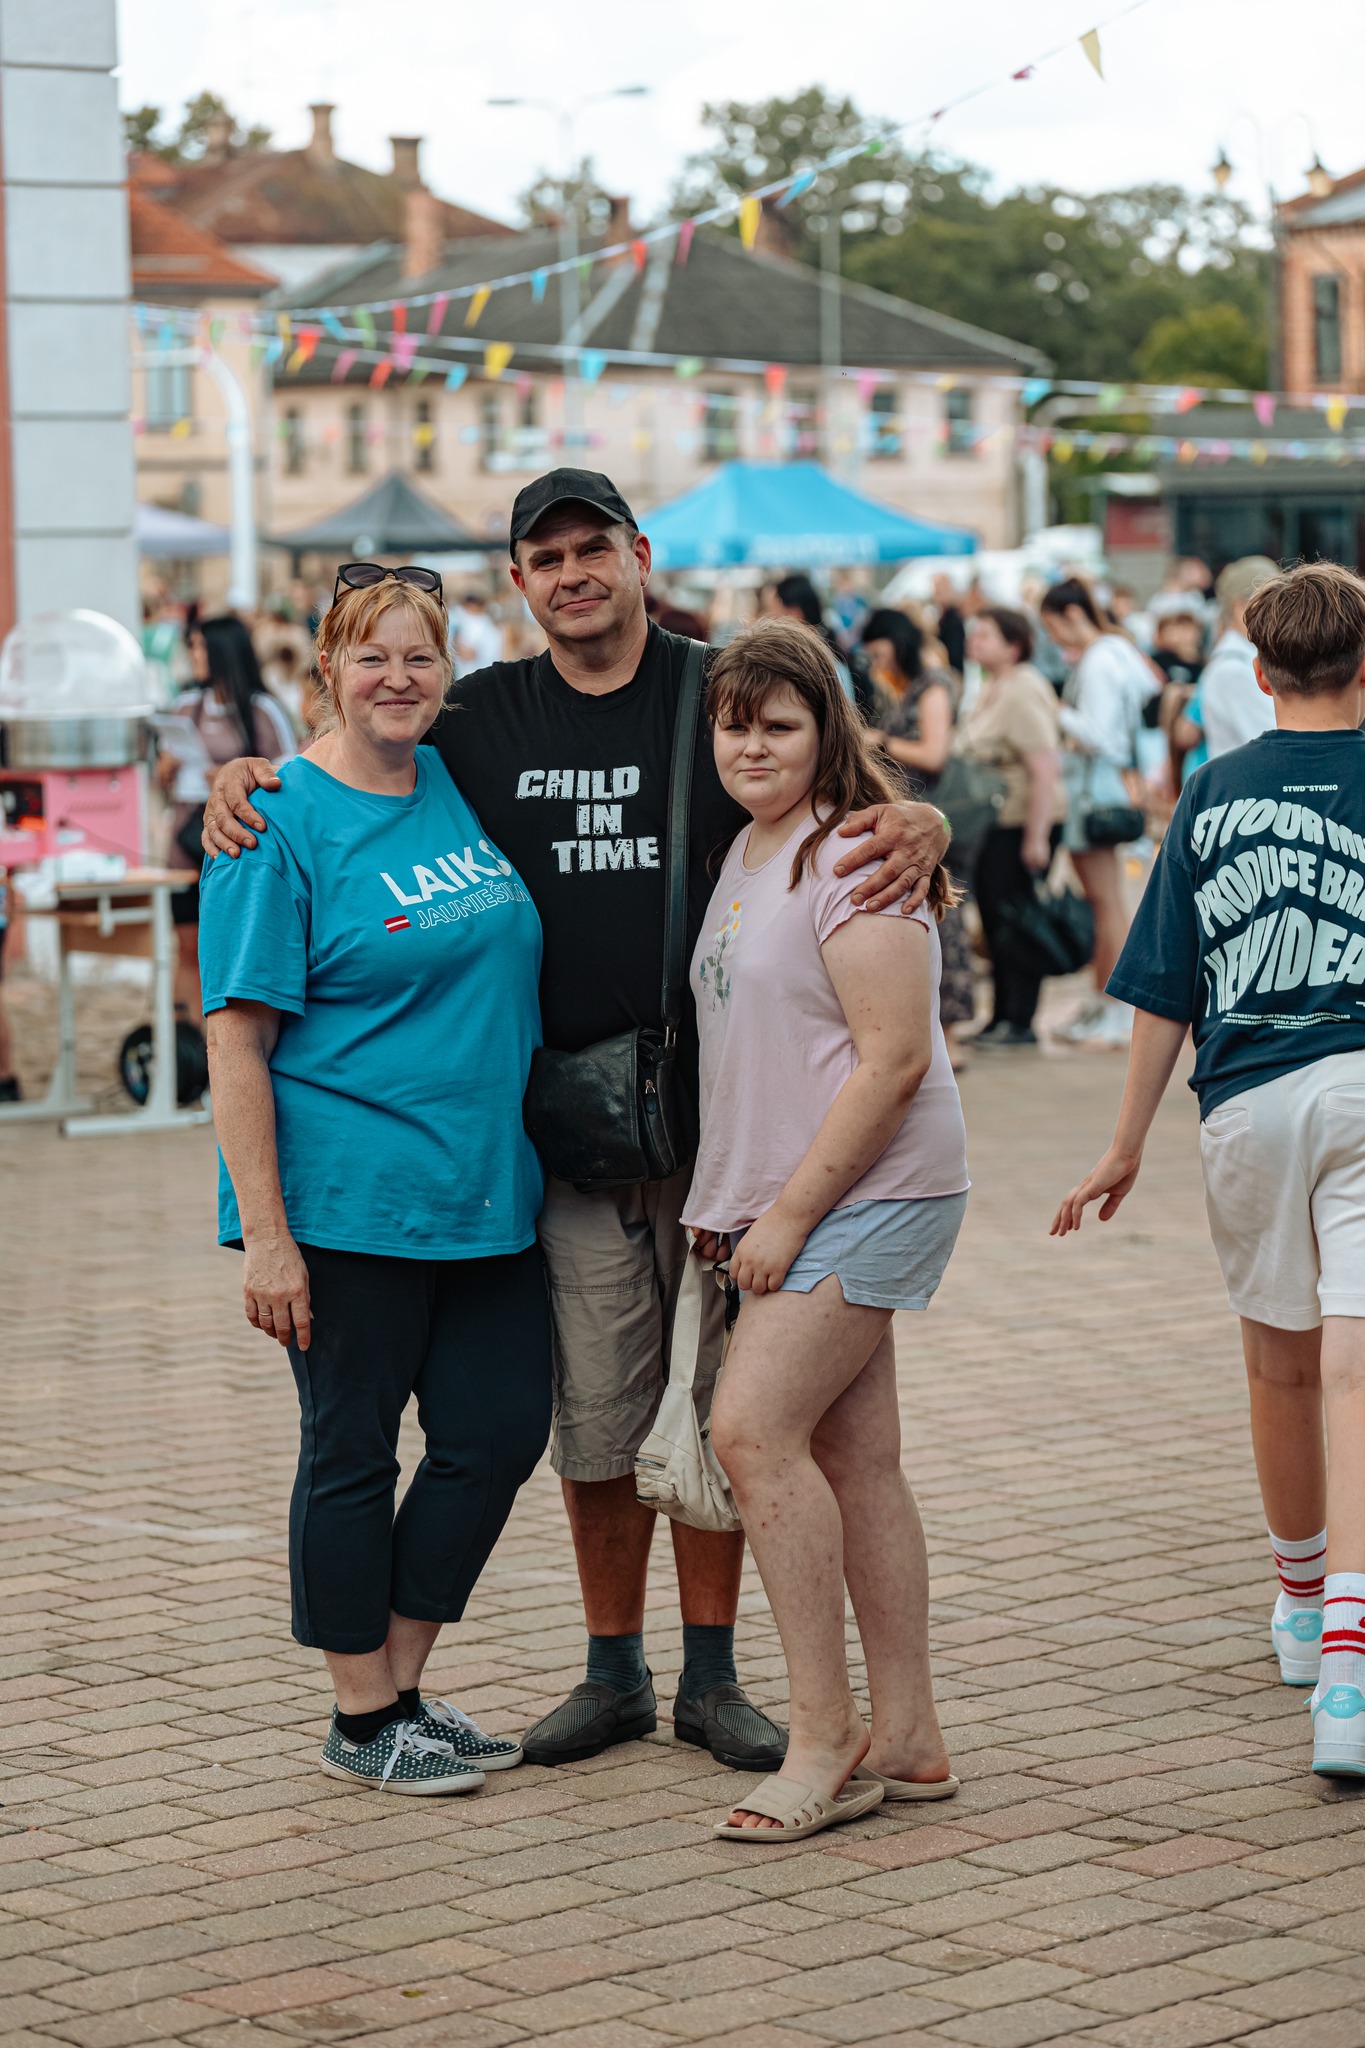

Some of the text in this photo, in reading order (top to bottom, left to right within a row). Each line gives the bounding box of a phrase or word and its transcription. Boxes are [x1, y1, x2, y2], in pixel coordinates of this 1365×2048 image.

[515, 765, 640, 800] CHILD
[577, 804, 623, 836] IN
[1219, 798, 1325, 848] YOUR
[379, 839, 512, 907] LAIKS
[551, 836, 661, 874] TIME
[1194, 845, 1317, 938] PRODUCE
